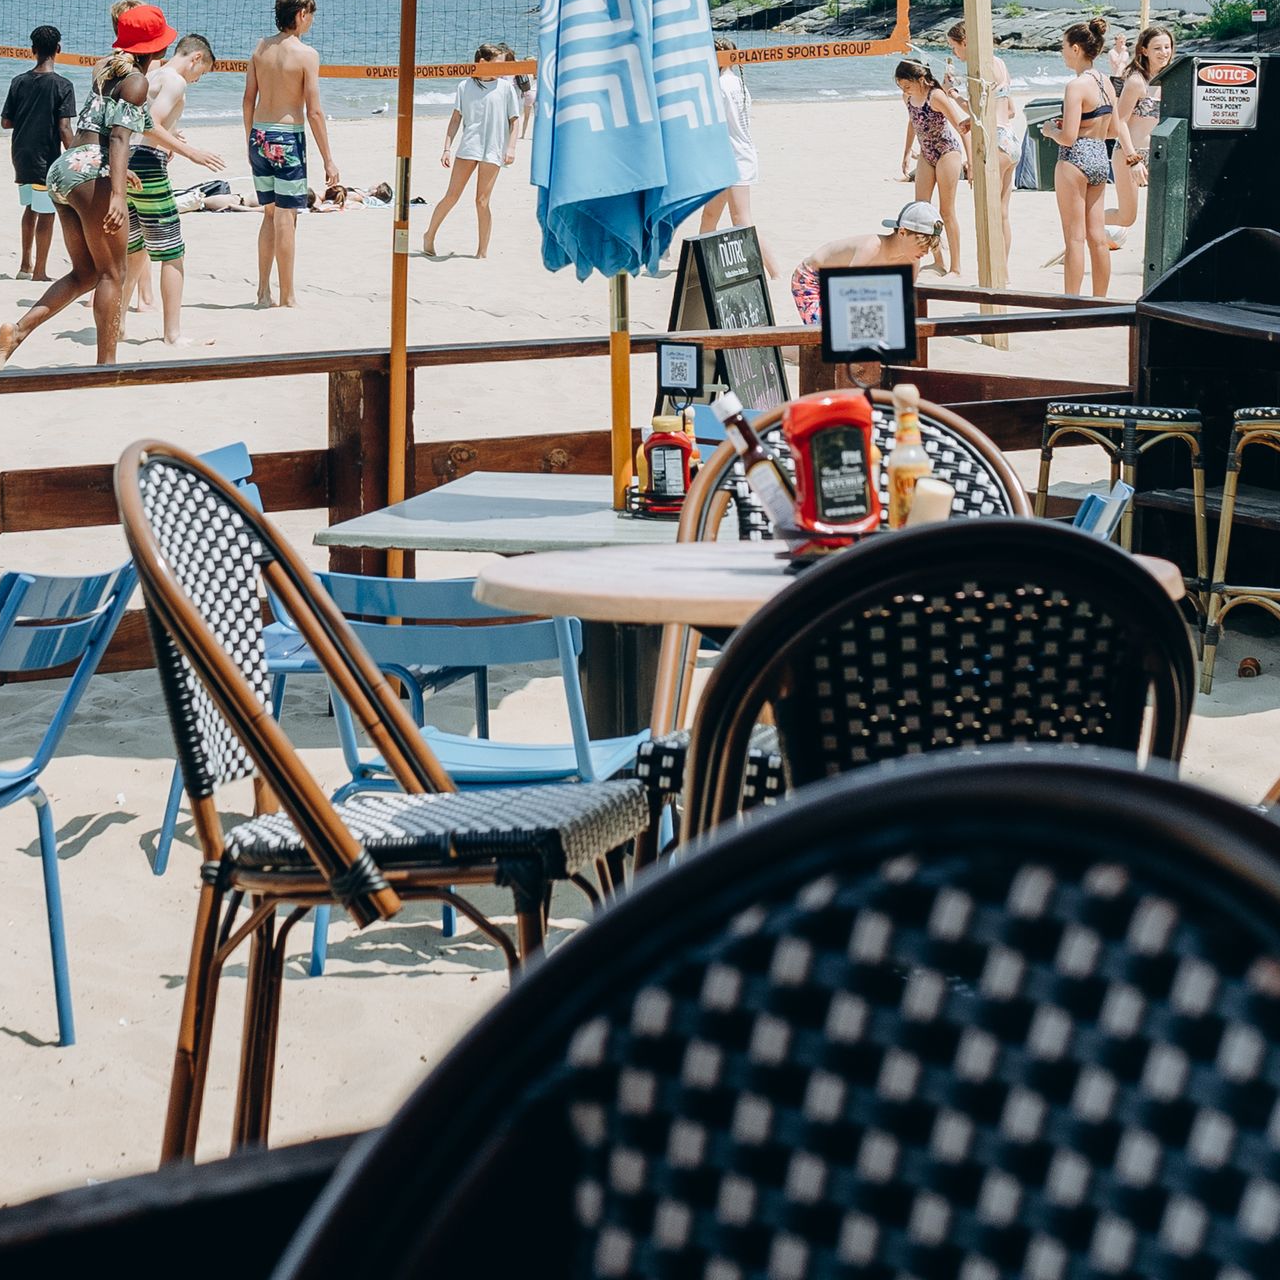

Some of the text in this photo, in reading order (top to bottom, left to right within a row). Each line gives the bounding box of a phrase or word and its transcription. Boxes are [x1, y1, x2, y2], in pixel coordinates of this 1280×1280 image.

[15, 49, 33, 59] GROU
[738, 42, 871, 63] PLAYERS SPORTS GROUP
[220, 61, 248, 72] PLAYER
[373, 64, 477, 78] PLAYE PORTS GROUP
[1207, 68, 1248, 80] NOTICE
